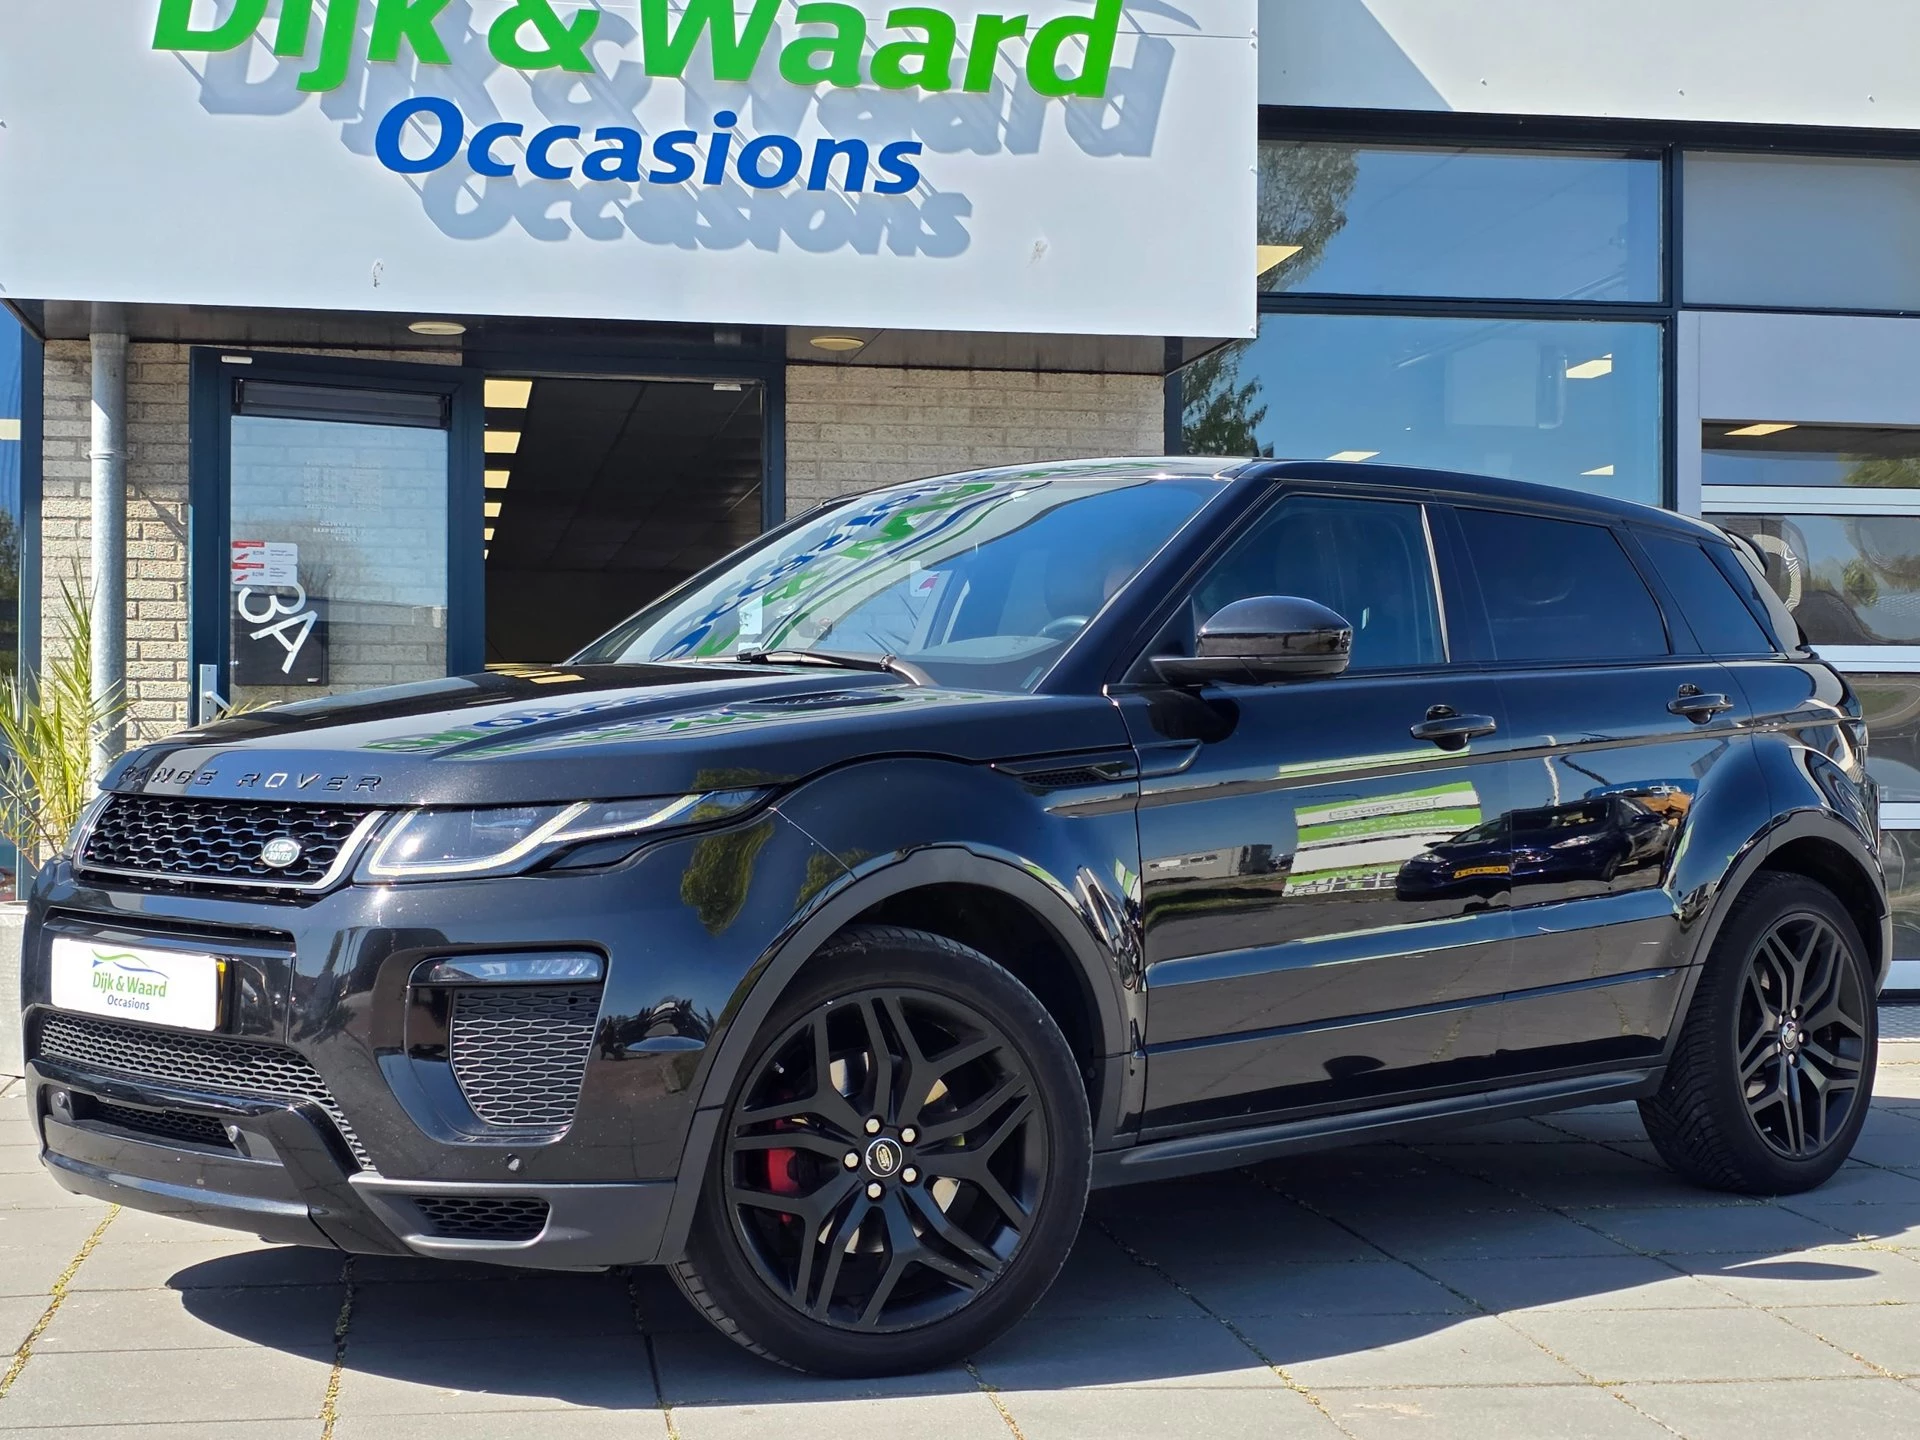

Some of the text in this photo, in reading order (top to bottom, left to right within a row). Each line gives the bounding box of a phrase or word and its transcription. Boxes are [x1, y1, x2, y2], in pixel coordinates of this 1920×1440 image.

[488, 0, 599, 73] &
[641, 0, 1121, 98] Waard
[375, 96, 922, 195] Occasions
[118, 764, 383, 793] RANGE ROVER
[92, 971, 168, 998] Dijk & Waard
[107, 994, 150, 1011] Occasions
